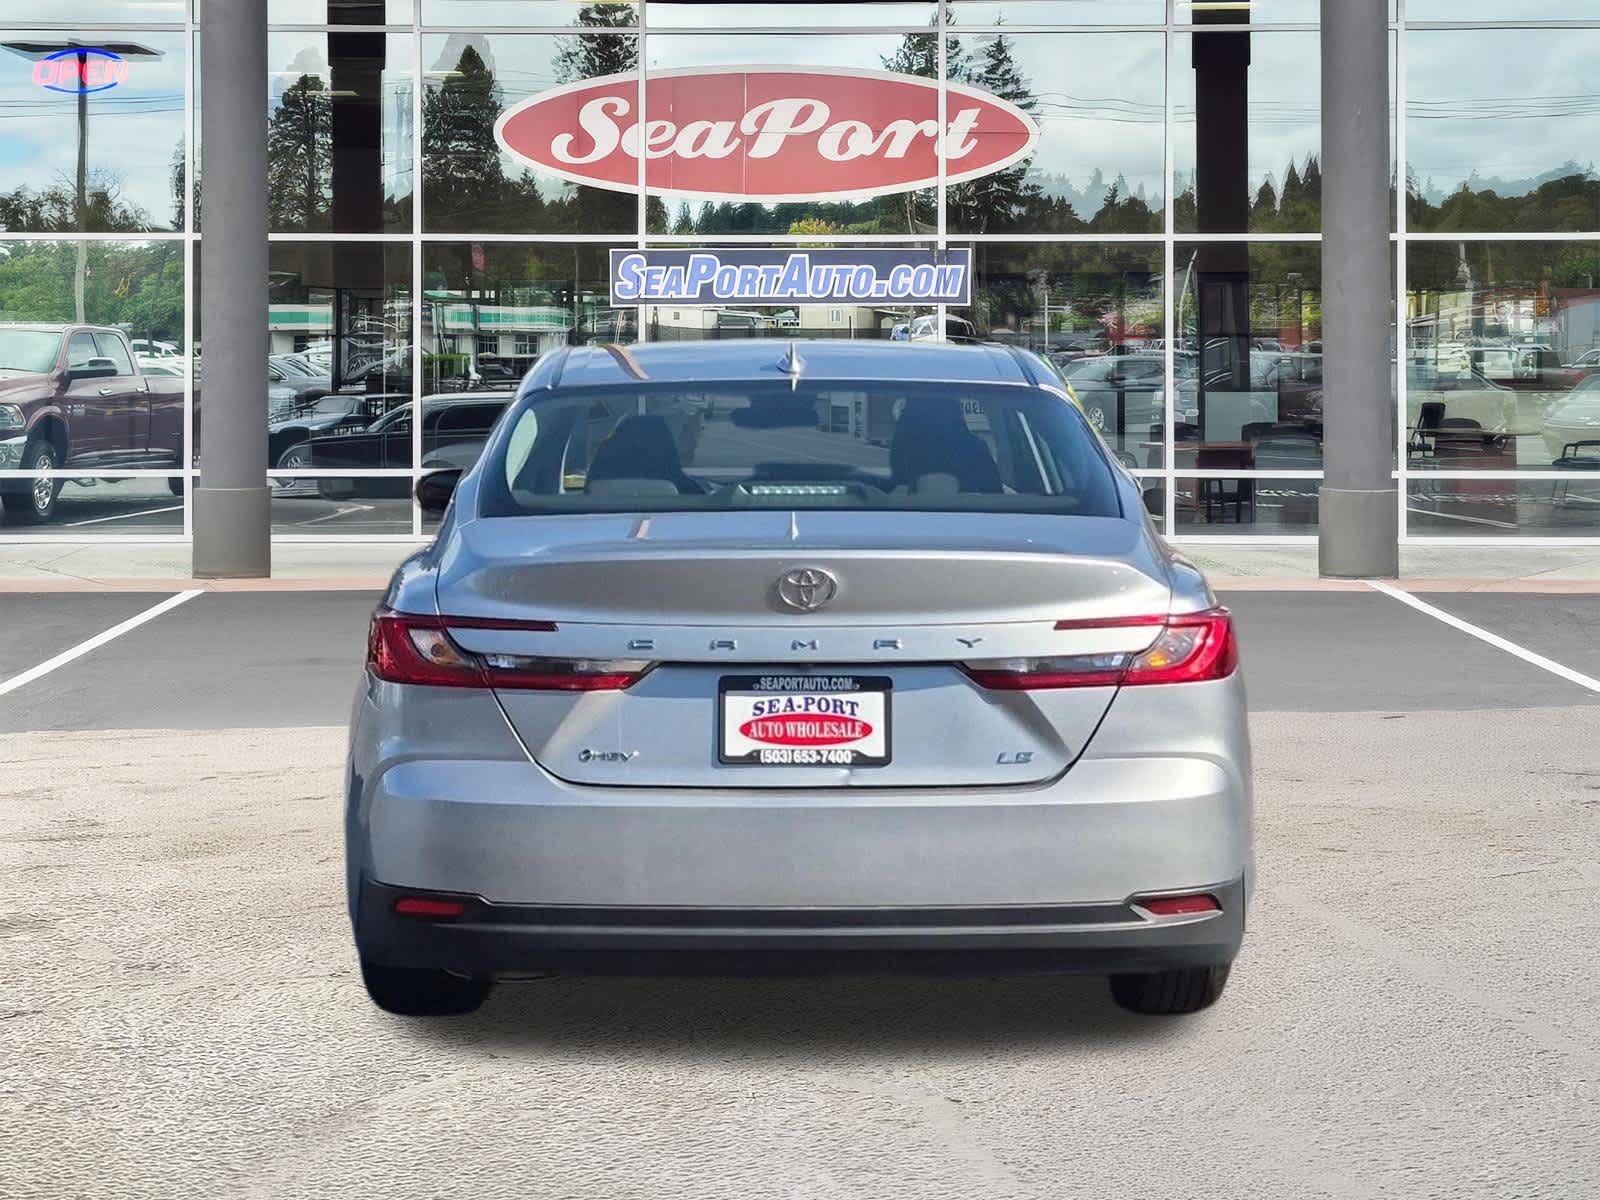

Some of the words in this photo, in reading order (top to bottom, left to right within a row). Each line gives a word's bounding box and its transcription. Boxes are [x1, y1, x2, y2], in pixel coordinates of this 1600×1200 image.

[32, 60, 128, 86] OPEN
[550, 96, 983, 164] SeaPort
[627, 637, 983, 651] CAMRY
[760, 677, 853, 690] SEAPORTAUTO.COM
[753, 697, 859, 716] SEA-PORT
[750, 722, 783, 738] AUTO
[786, 721, 864, 738] WHOLESALE
[760, 750, 792, 764] (503)
[793, 750, 852, 764] 653-7400
